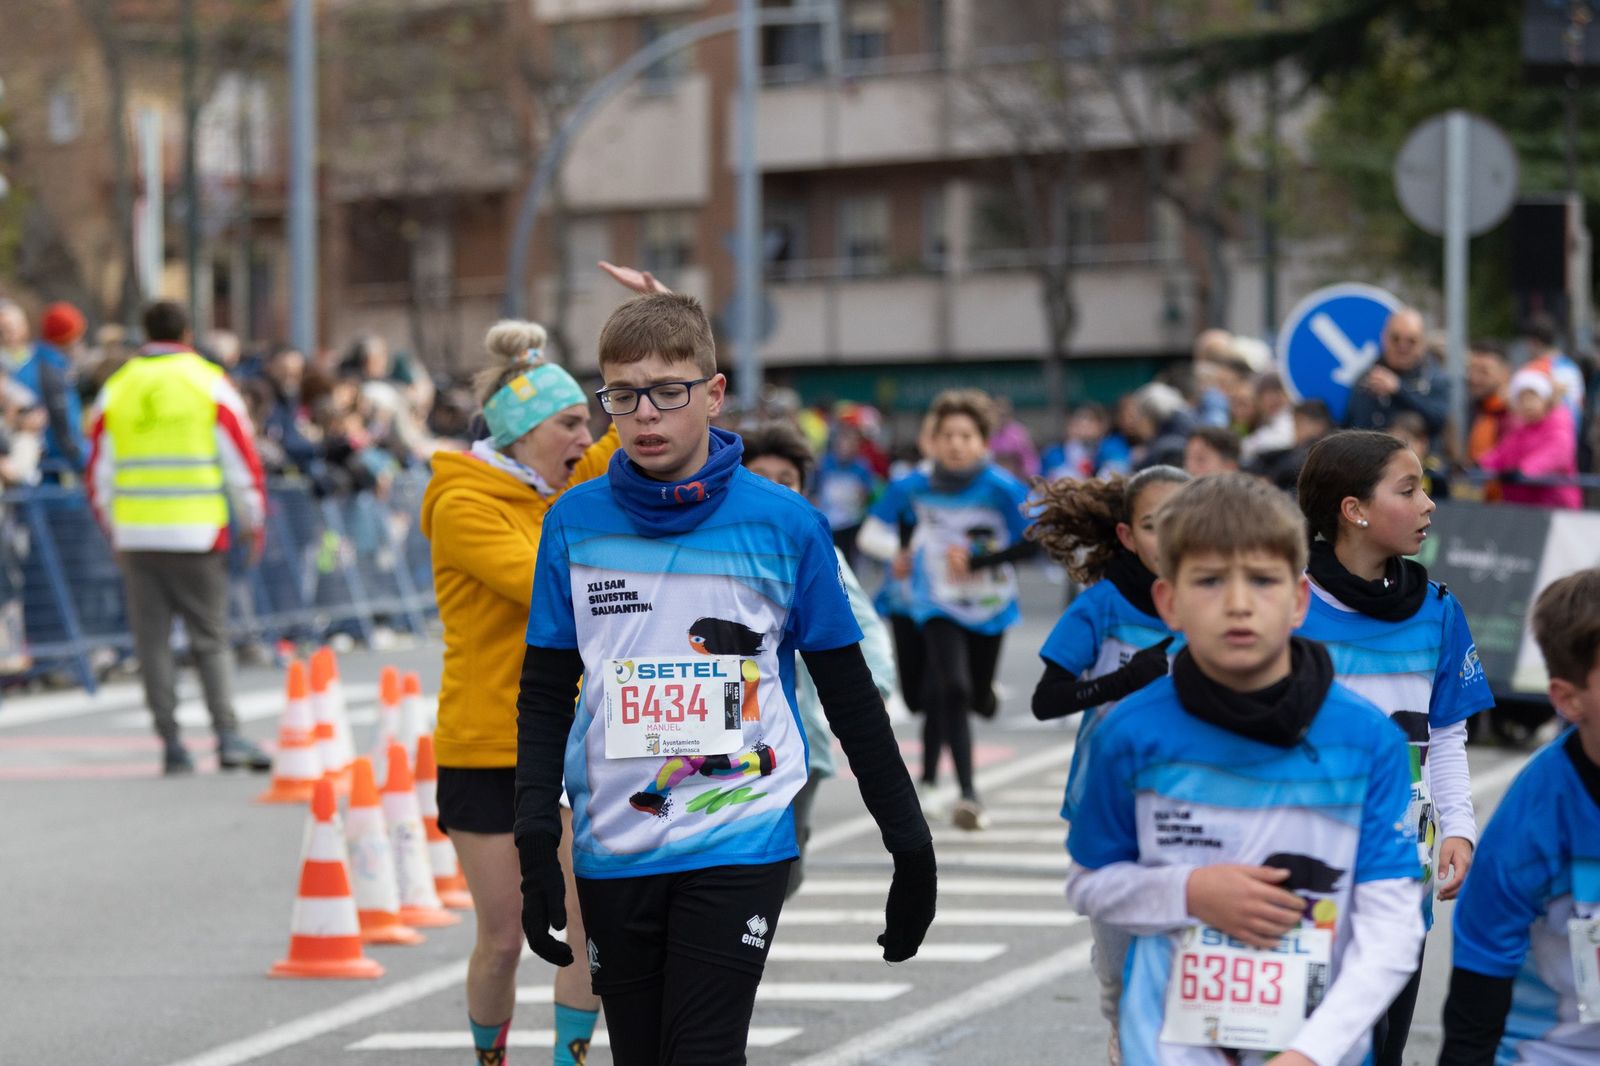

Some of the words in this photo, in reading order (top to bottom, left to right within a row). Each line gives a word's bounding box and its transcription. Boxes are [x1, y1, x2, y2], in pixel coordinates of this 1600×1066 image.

[587, 582, 603, 593] XLI
[604, 579, 626, 591] SAN
[588, 591, 639, 605] SILVESTRE
[637, 661, 727, 680] SETEL
[621, 683, 708, 725] 6434
[646, 723, 681, 732] MANUEL
[662, 739, 700, 748] Ayuntamiento
[1182, 954, 1283, 1006] 6393
